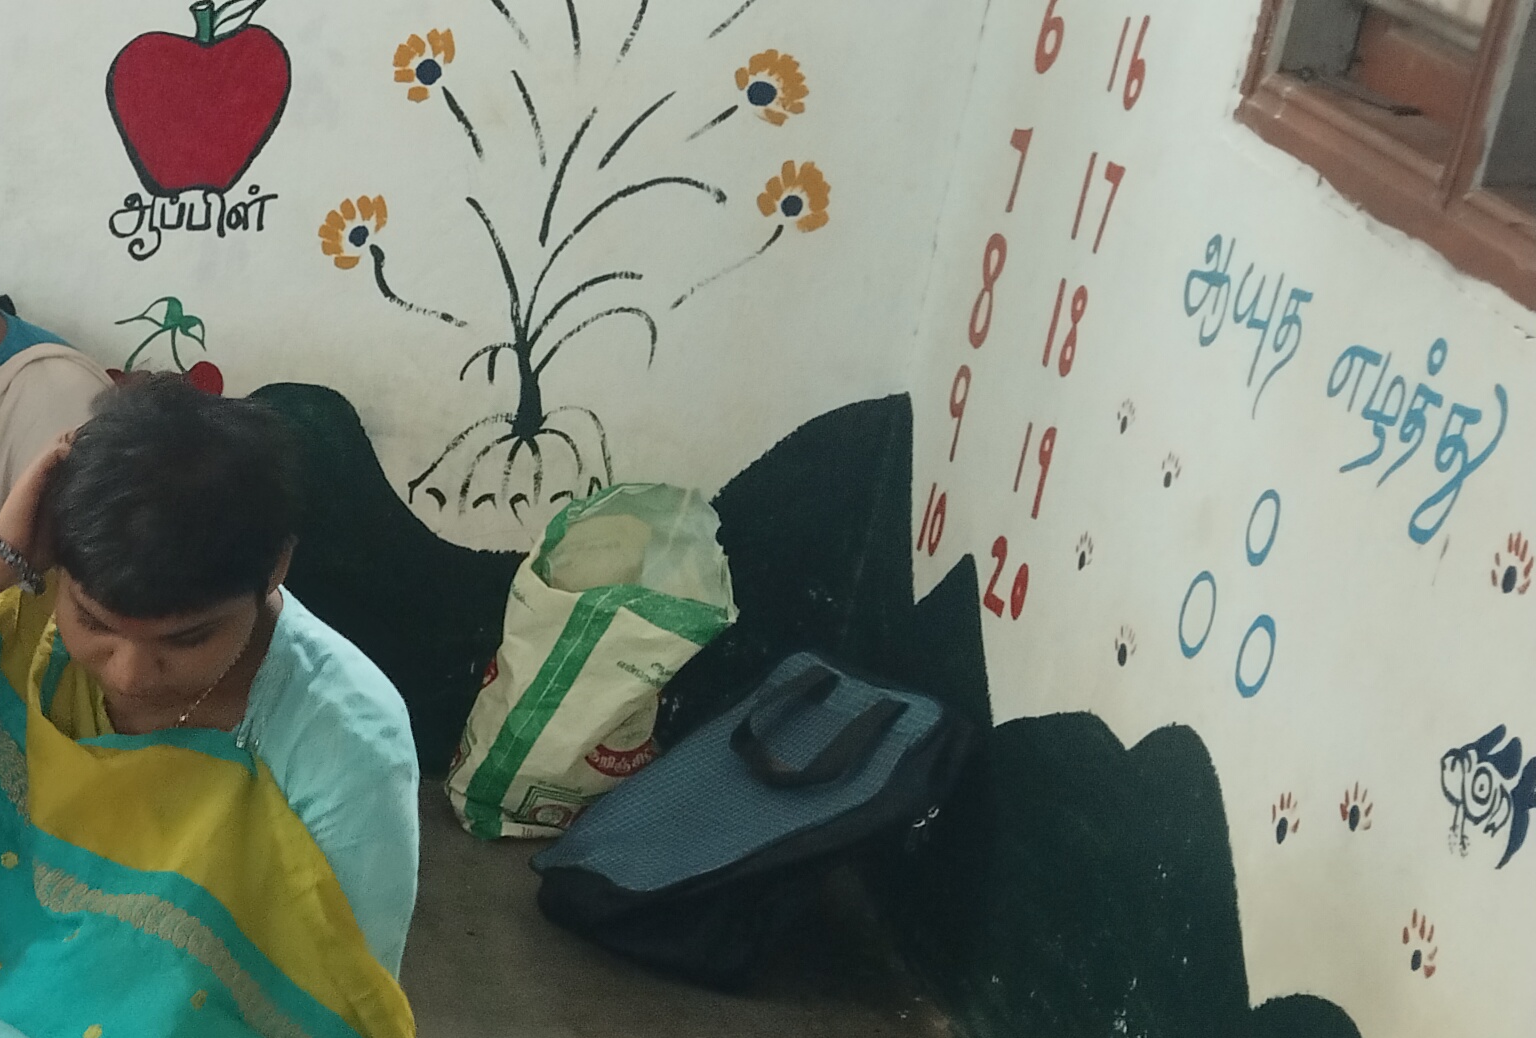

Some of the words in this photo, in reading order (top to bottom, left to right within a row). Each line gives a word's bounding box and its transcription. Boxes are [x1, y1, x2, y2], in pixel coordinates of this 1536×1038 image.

[1034, 0, 1065, 74] 6
[1107, 15, 1151, 111] 16
[1005, 126, 1034, 213] 7
[1071, 151, 1126, 254] 17
[968, 233, 1008, 349] 8
[1042, 277, 1088, 377] 18
[949, 365, 972, 463] 9
[1013, 422, 1057, 520] 19
[917, 482, 947, 557] 10
[983, 536, 1029, 621] 20
